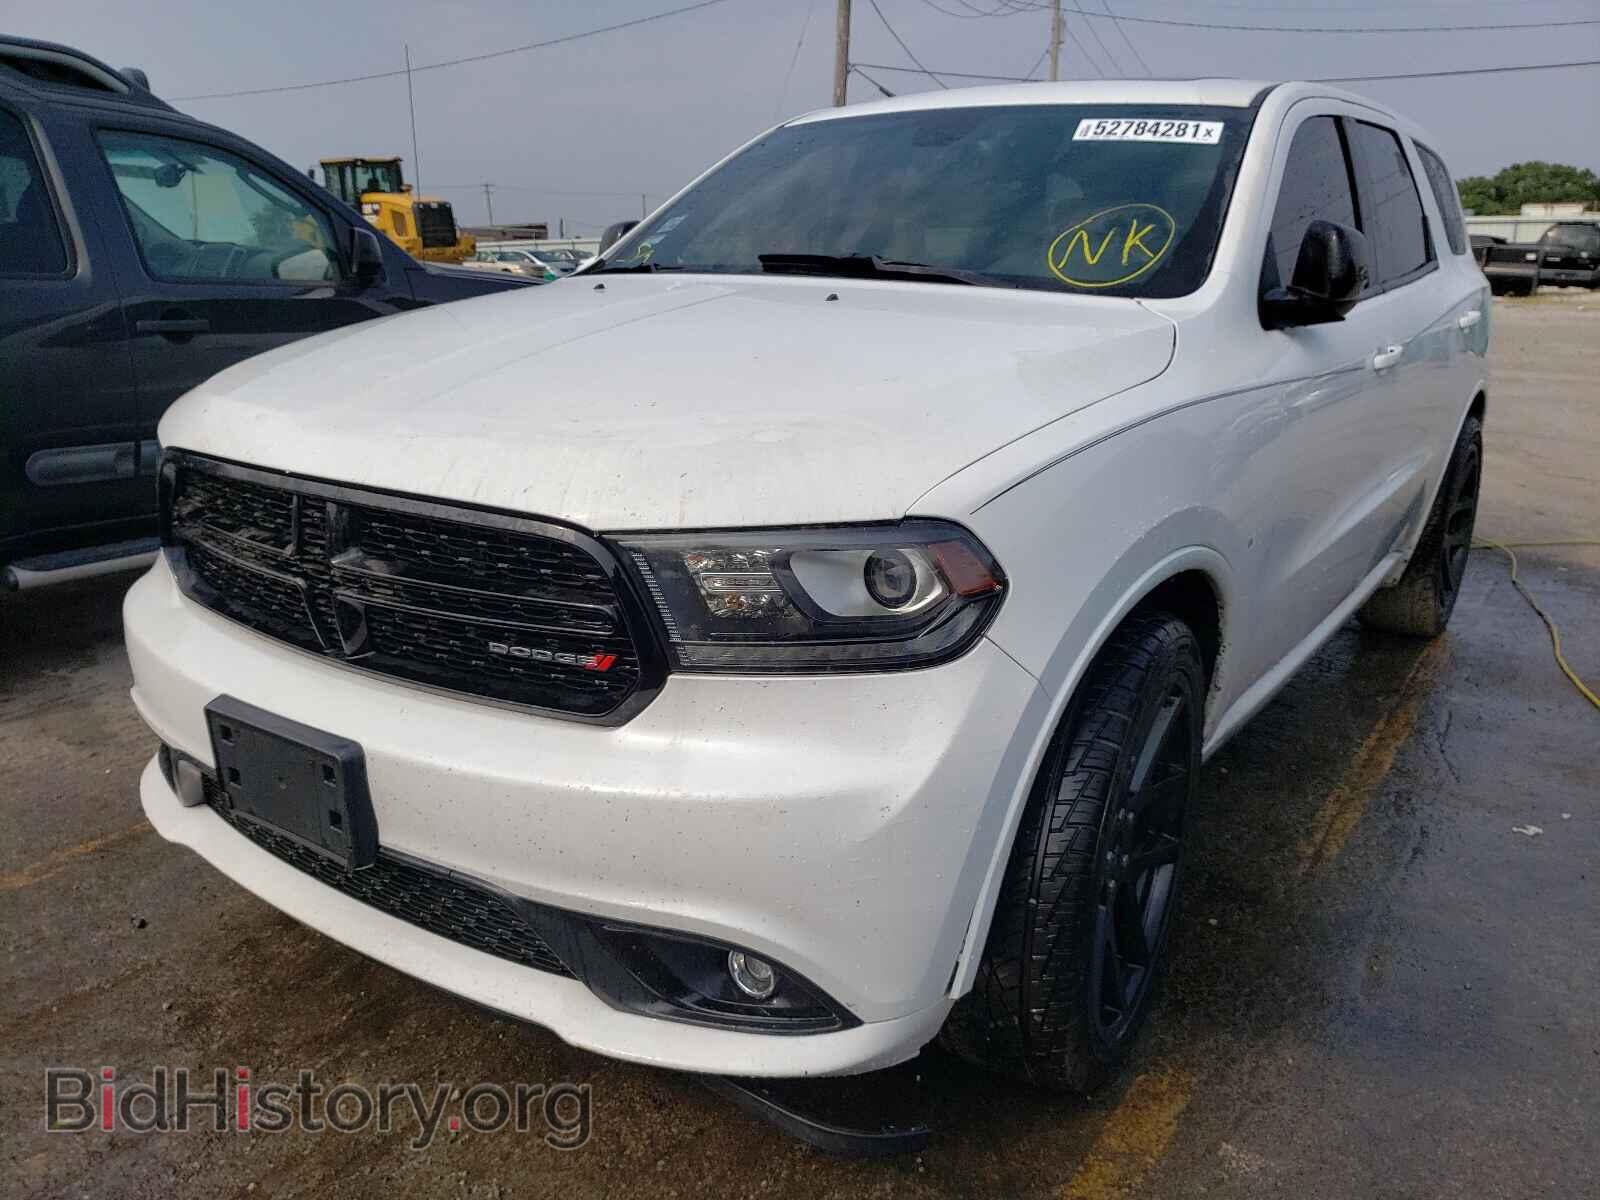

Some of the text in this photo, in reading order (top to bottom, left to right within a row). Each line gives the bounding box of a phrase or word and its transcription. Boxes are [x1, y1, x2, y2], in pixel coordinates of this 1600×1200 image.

[1093, 121, 1200, 139] 52784281
[1057, 218, 1156, 269] NK
[488, 642, 597, 667] DODGE
